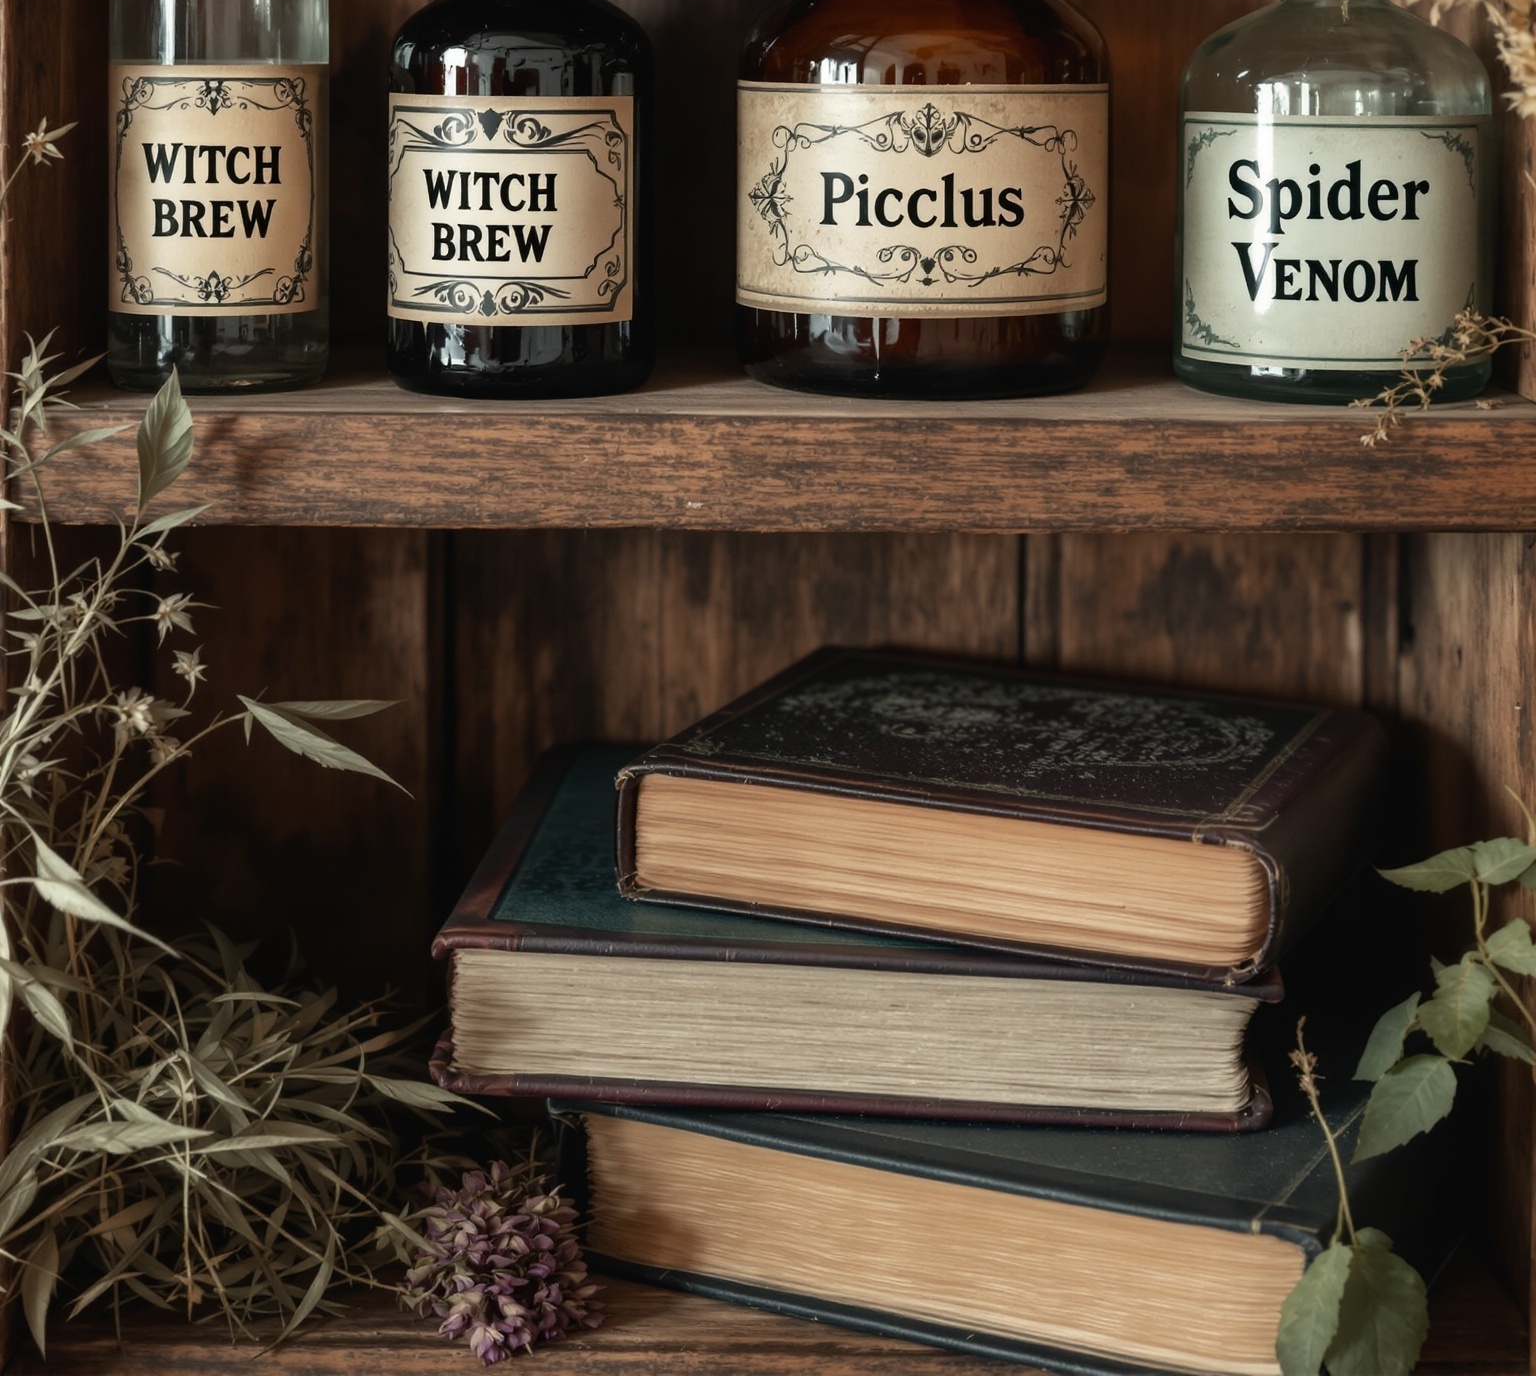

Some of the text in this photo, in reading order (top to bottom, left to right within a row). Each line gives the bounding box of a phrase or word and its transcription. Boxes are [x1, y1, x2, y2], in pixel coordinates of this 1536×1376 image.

[143, 142, 282, 185] WITCH
[424, 169, 558, 212] WITCH
[820, 172, 1025, 228] Picclus
[1227, 159, 1430, 234] Spider
[152, 198, 277, 239] BREW
[431, 224, 553, 263] BREW
